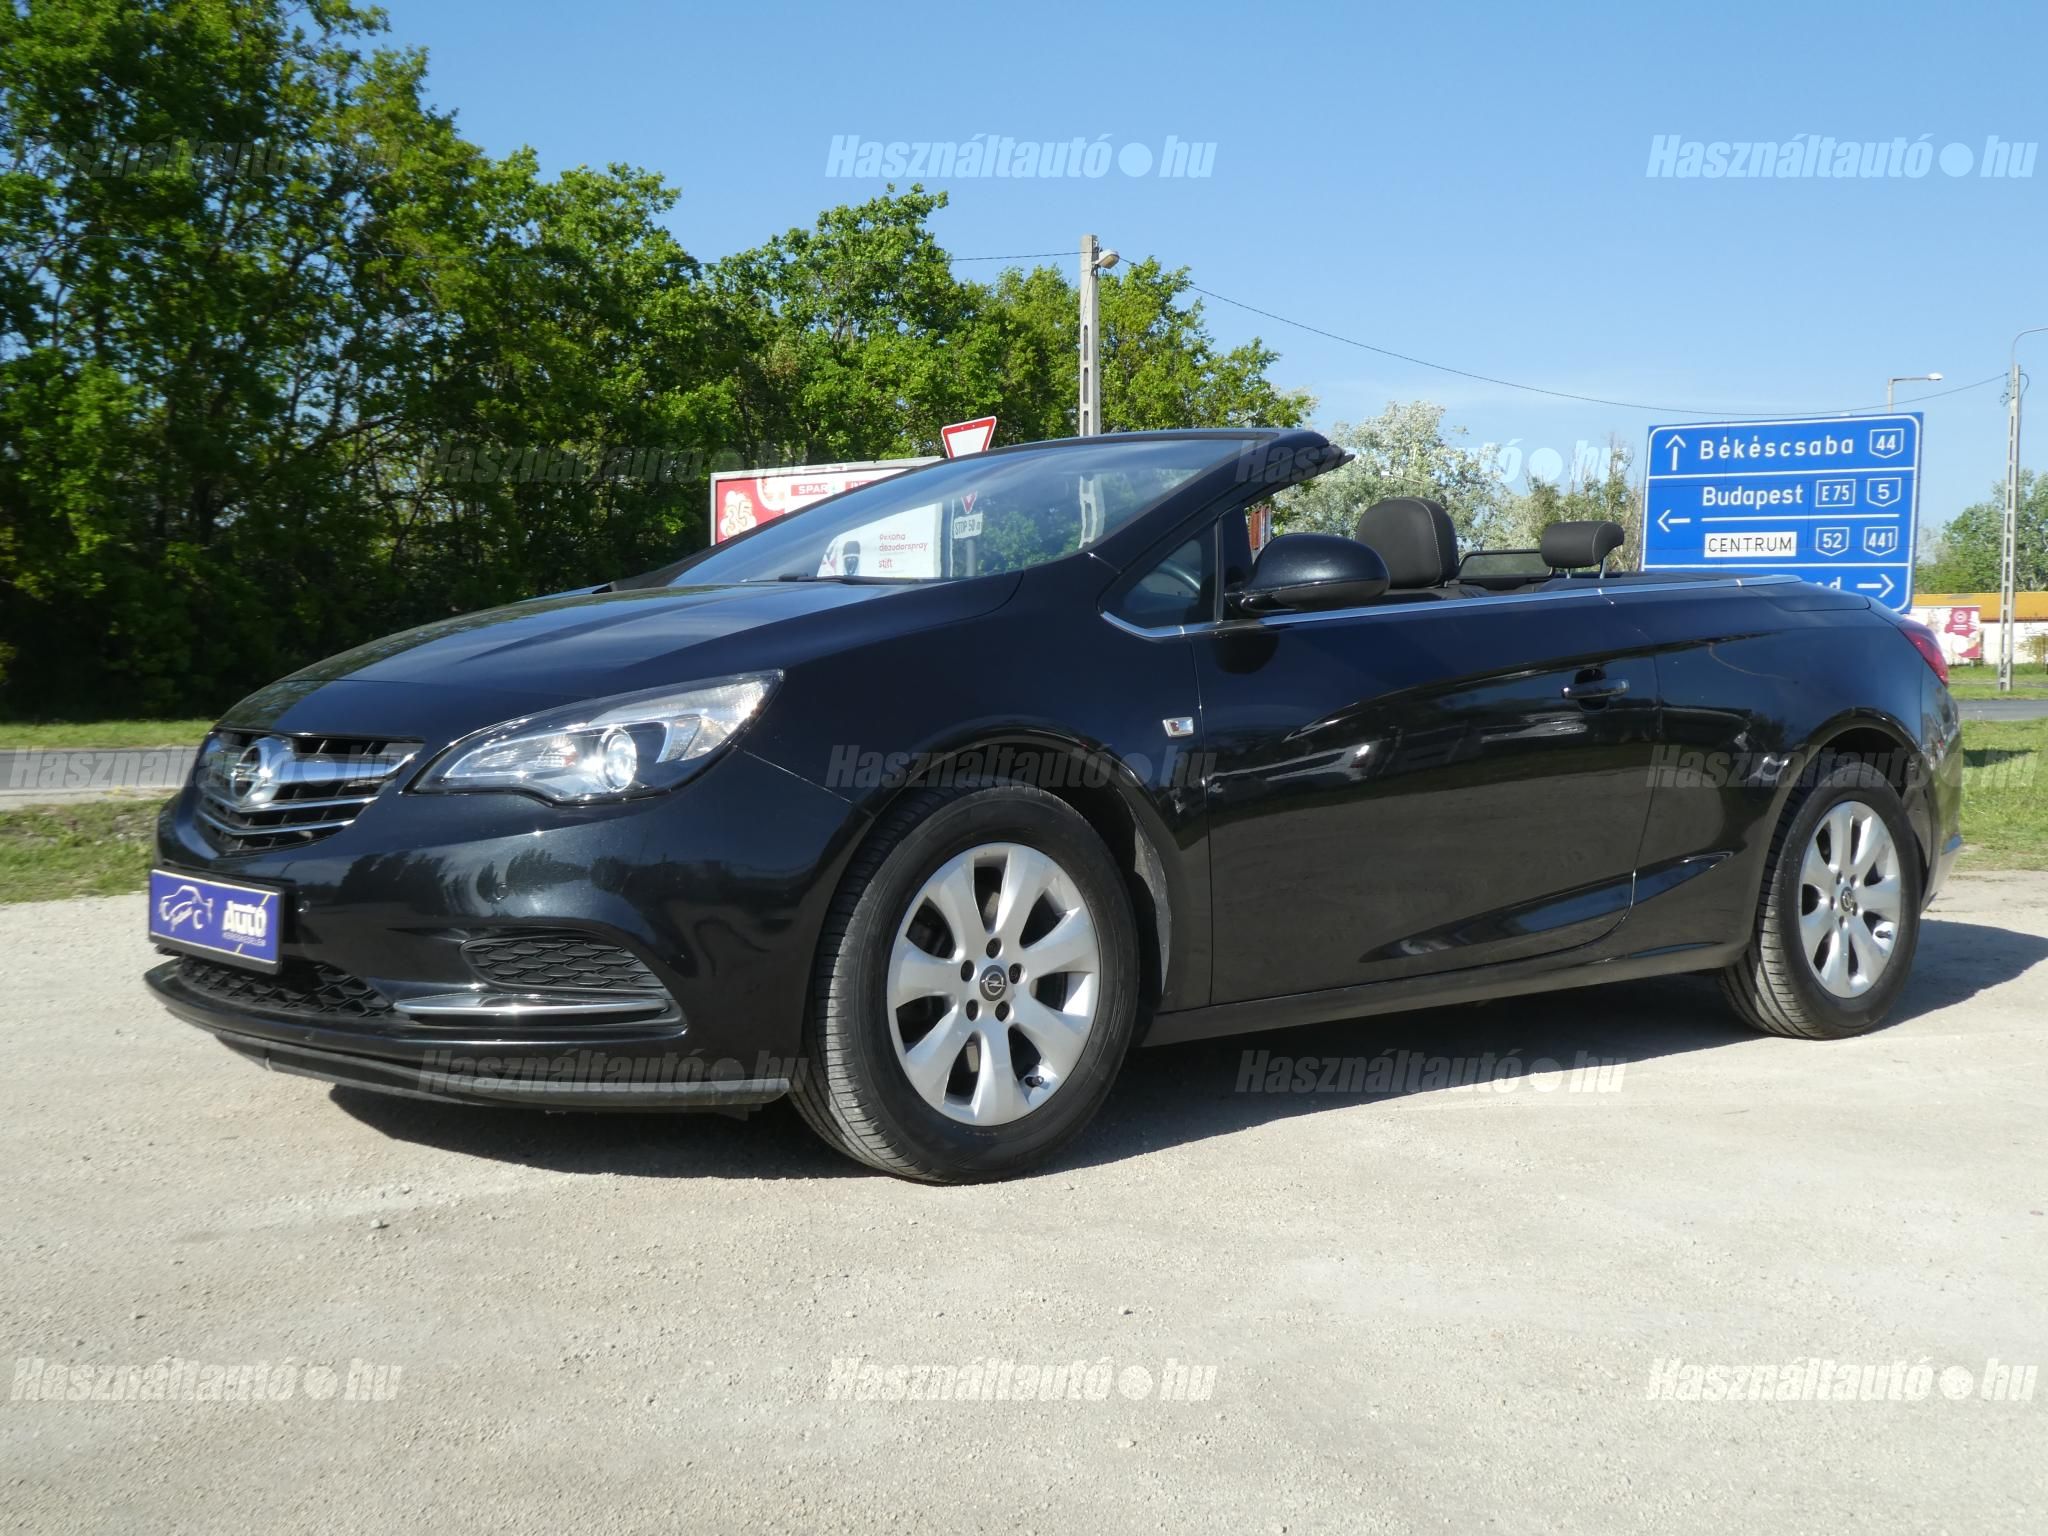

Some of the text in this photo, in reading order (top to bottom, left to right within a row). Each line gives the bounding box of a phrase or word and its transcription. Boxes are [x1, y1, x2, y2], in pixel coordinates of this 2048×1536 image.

[1700, 434, 1897, 460] Békéscsaba 44
[798, 484, 828, 495] SPAR
[1702, 484, 1804, 510] Budapest
[1877, 484, 1890, 500] 5
[1708, 532, 1894, 553] CENTRUM 52 441
